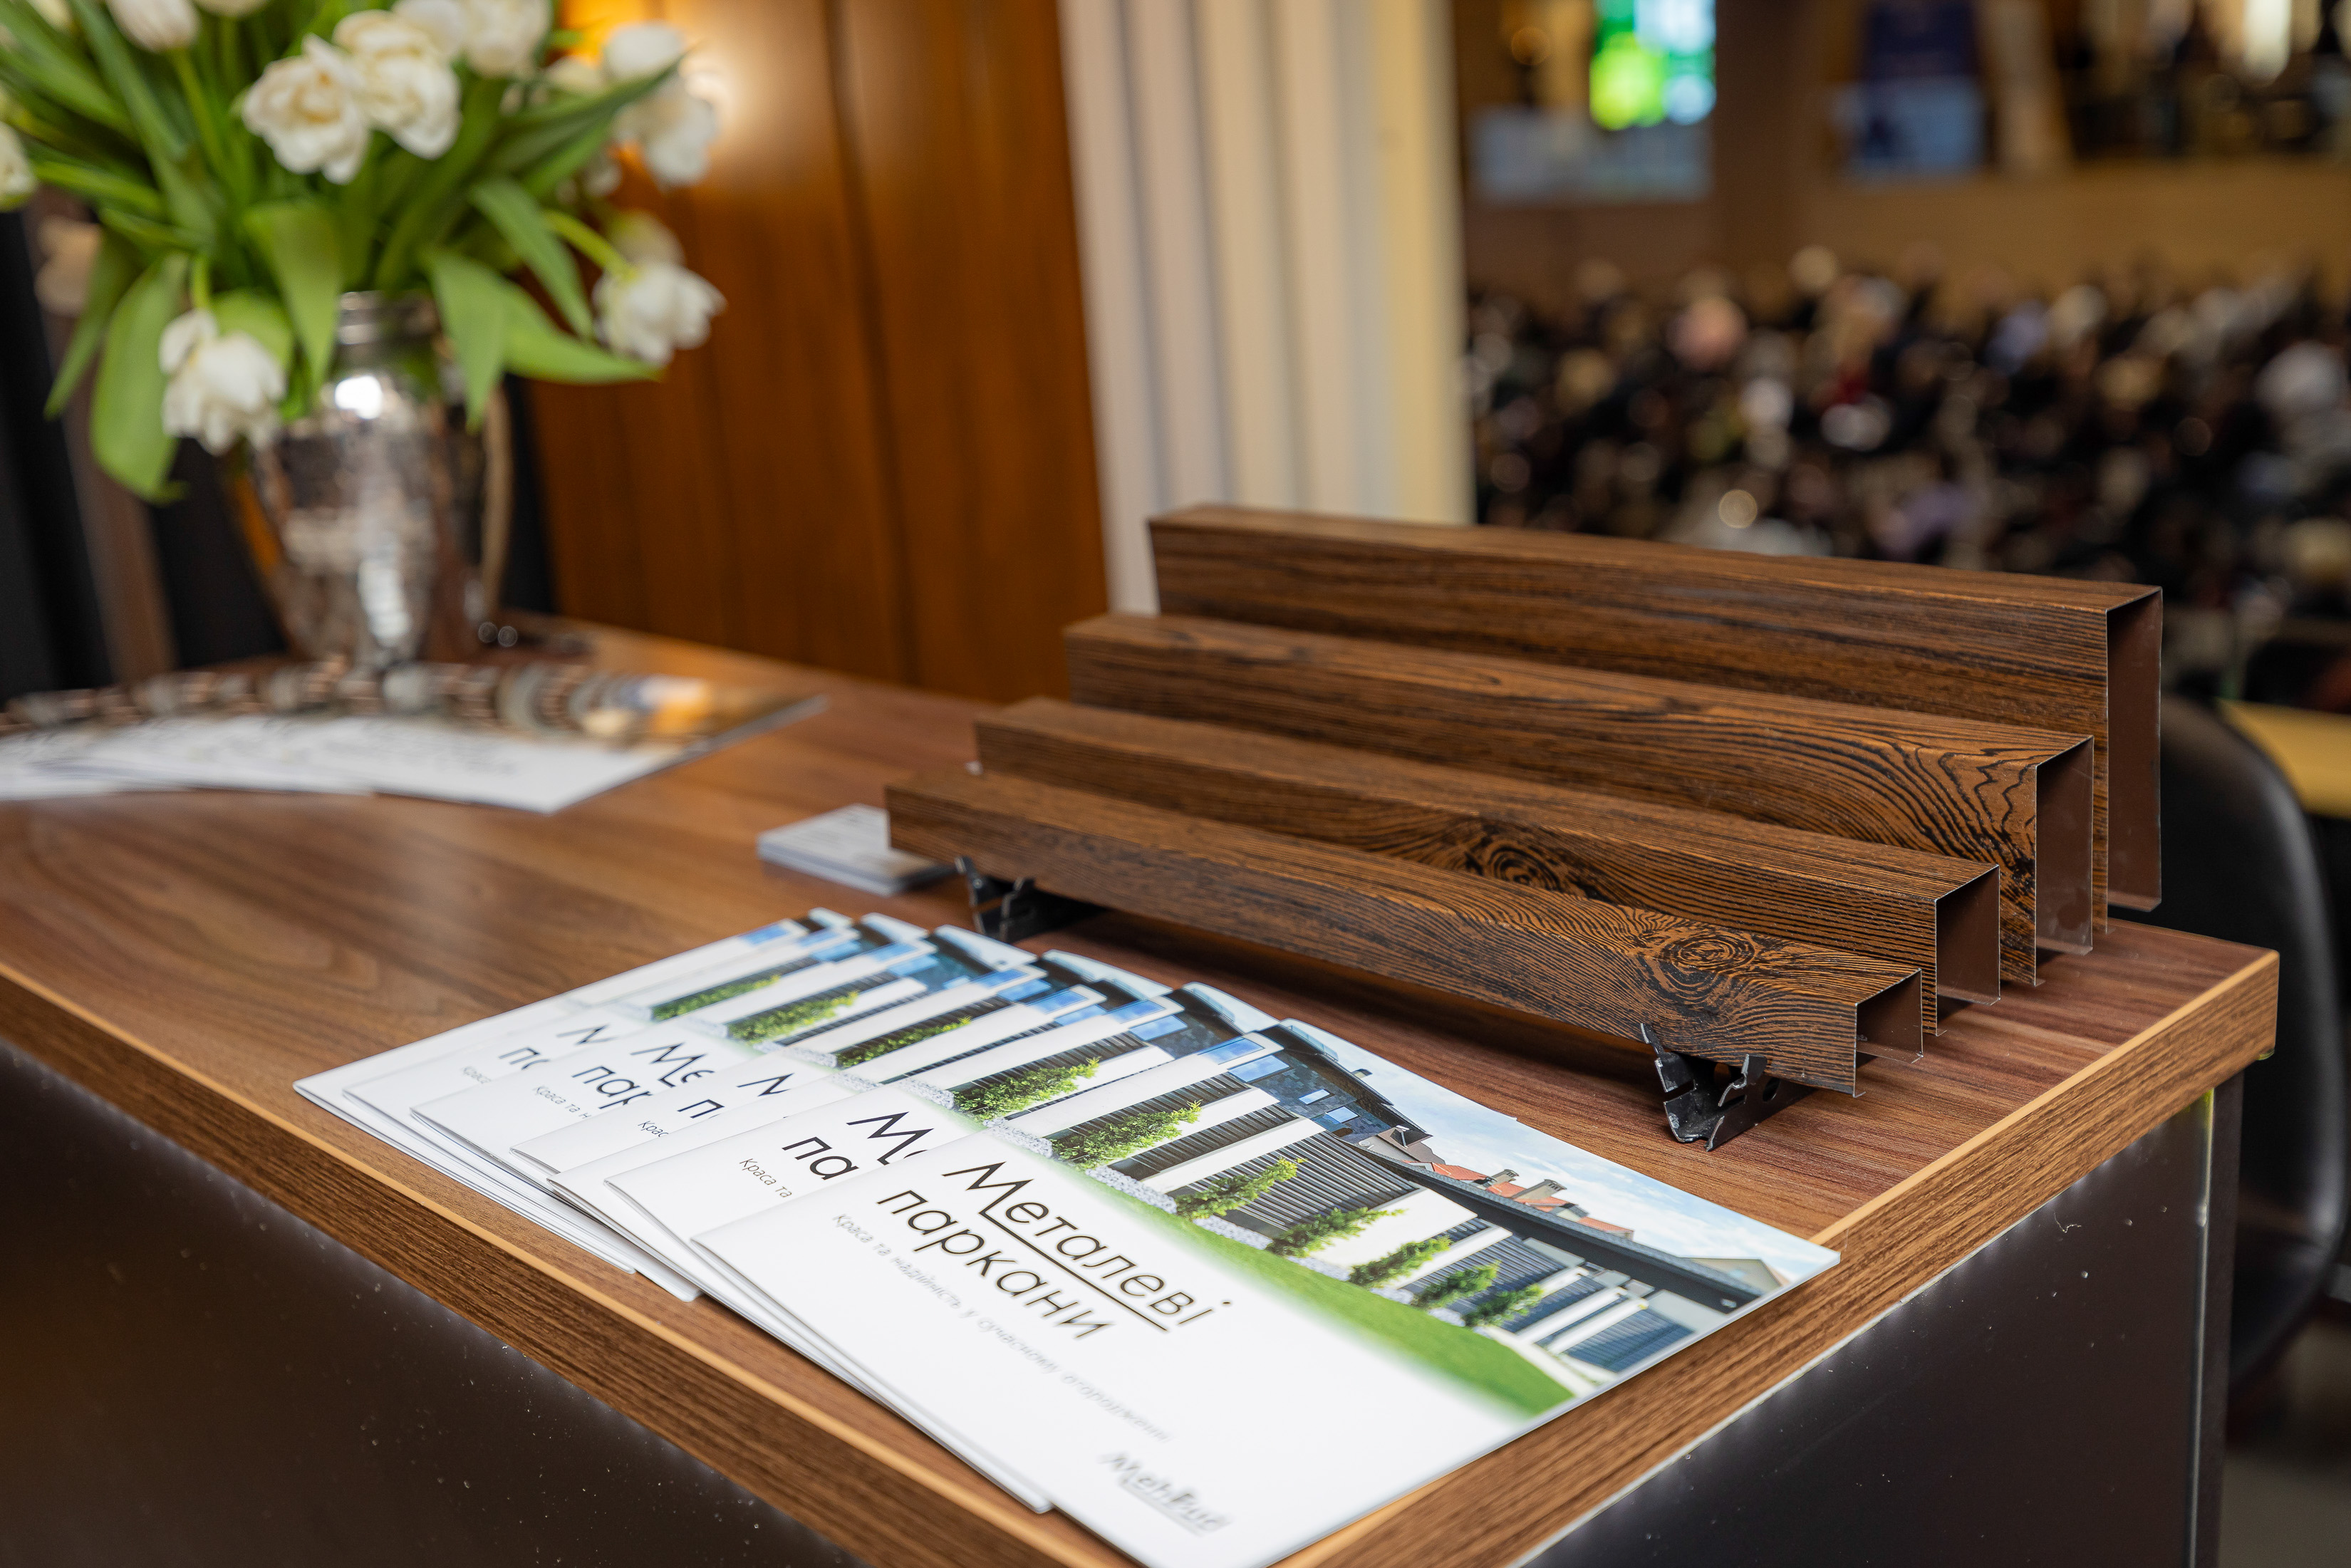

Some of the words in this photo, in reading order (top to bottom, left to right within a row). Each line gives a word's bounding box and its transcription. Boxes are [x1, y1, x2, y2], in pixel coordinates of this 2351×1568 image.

[534, 1085, 566, 1105] Краса
[564, 1104, 581, 1113] та
[638, 1121, 669, 1138] Крас
[739, 1158, 777, 1186] Краса
[775, 1185, 792, 1198] та
[876, 1189, 1116, 1339] паркани
[942, 1161, 1232, 1331] Металеві
[832, 1214, 873, 1242] Краса
[873, 1242, 892, 1256] та
[891, 1256, 962, 1309] надійність
[977, 1317, 1062, 1375] сучасному
